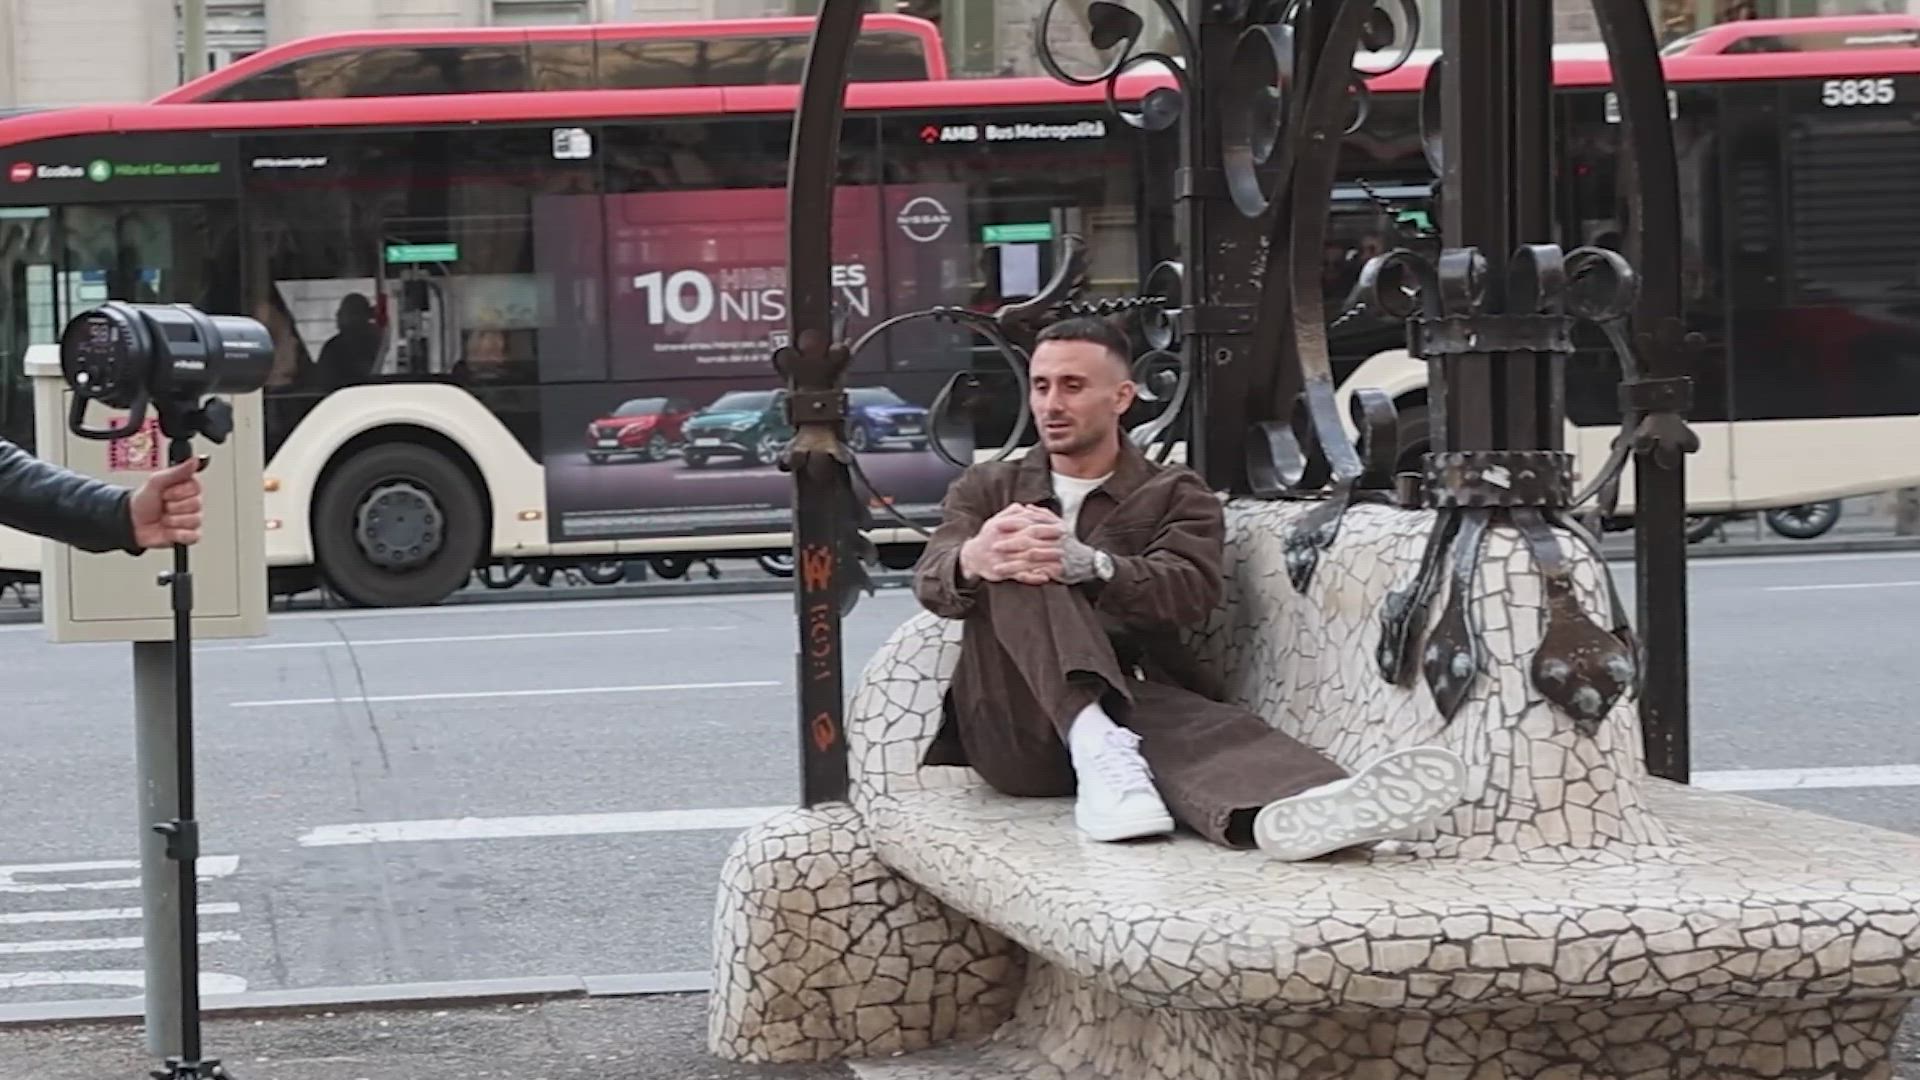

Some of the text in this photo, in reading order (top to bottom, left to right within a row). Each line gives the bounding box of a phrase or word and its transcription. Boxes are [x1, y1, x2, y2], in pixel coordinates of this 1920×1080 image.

[1823, 79, 1895, 106] 5835
[940, 125, 978, 142] AMB
[985, 124, 1014, 140] Bus
[896, 215, 951, 224] NISSAN
[633, 269, 715, 325] 10
[719, 286, 870, 322] NISN
